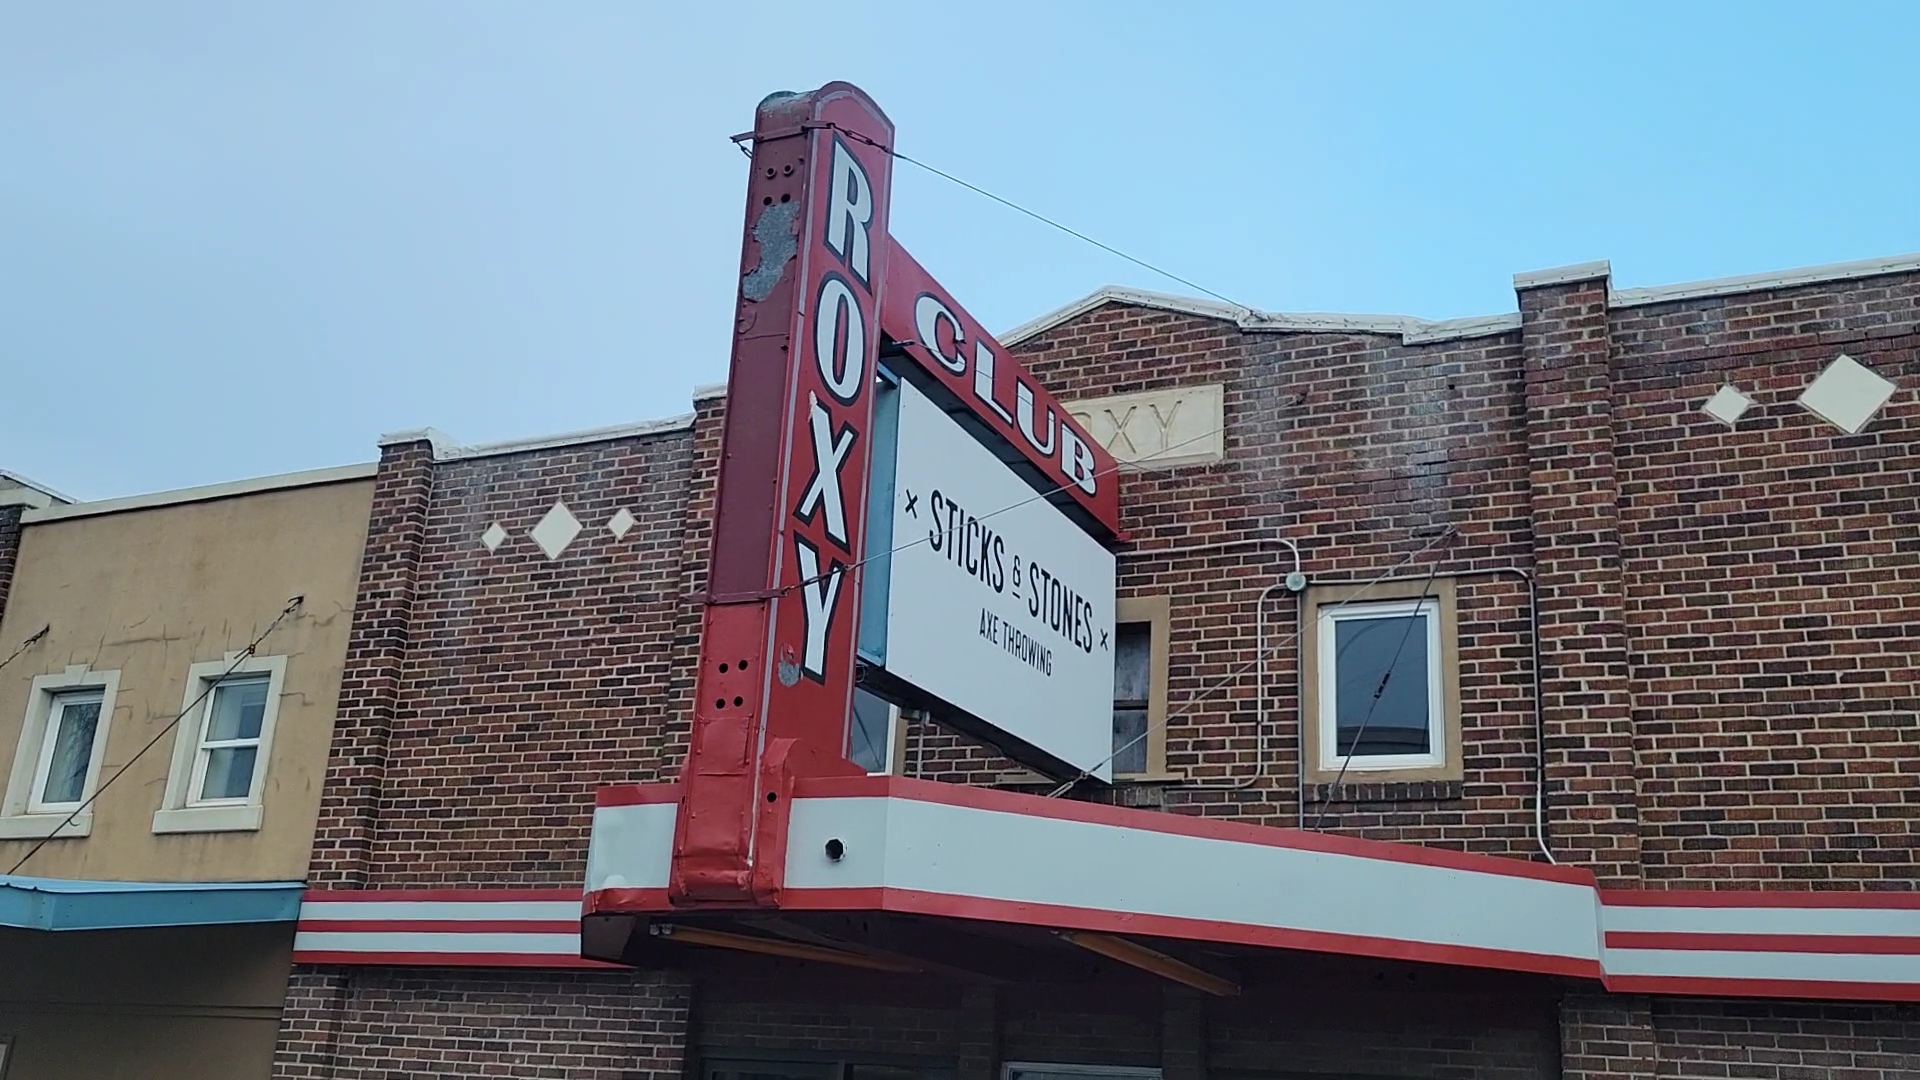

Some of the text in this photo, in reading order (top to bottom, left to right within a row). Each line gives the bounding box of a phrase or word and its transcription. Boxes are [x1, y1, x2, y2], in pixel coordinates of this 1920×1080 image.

[793, 135, 873, 683] ROXY
[914, 292, 1098, 496] CLUB
[929, 489, 1093, 654] STICKS & STONES
[979, 607, 1052, 677] AXE THROWING
